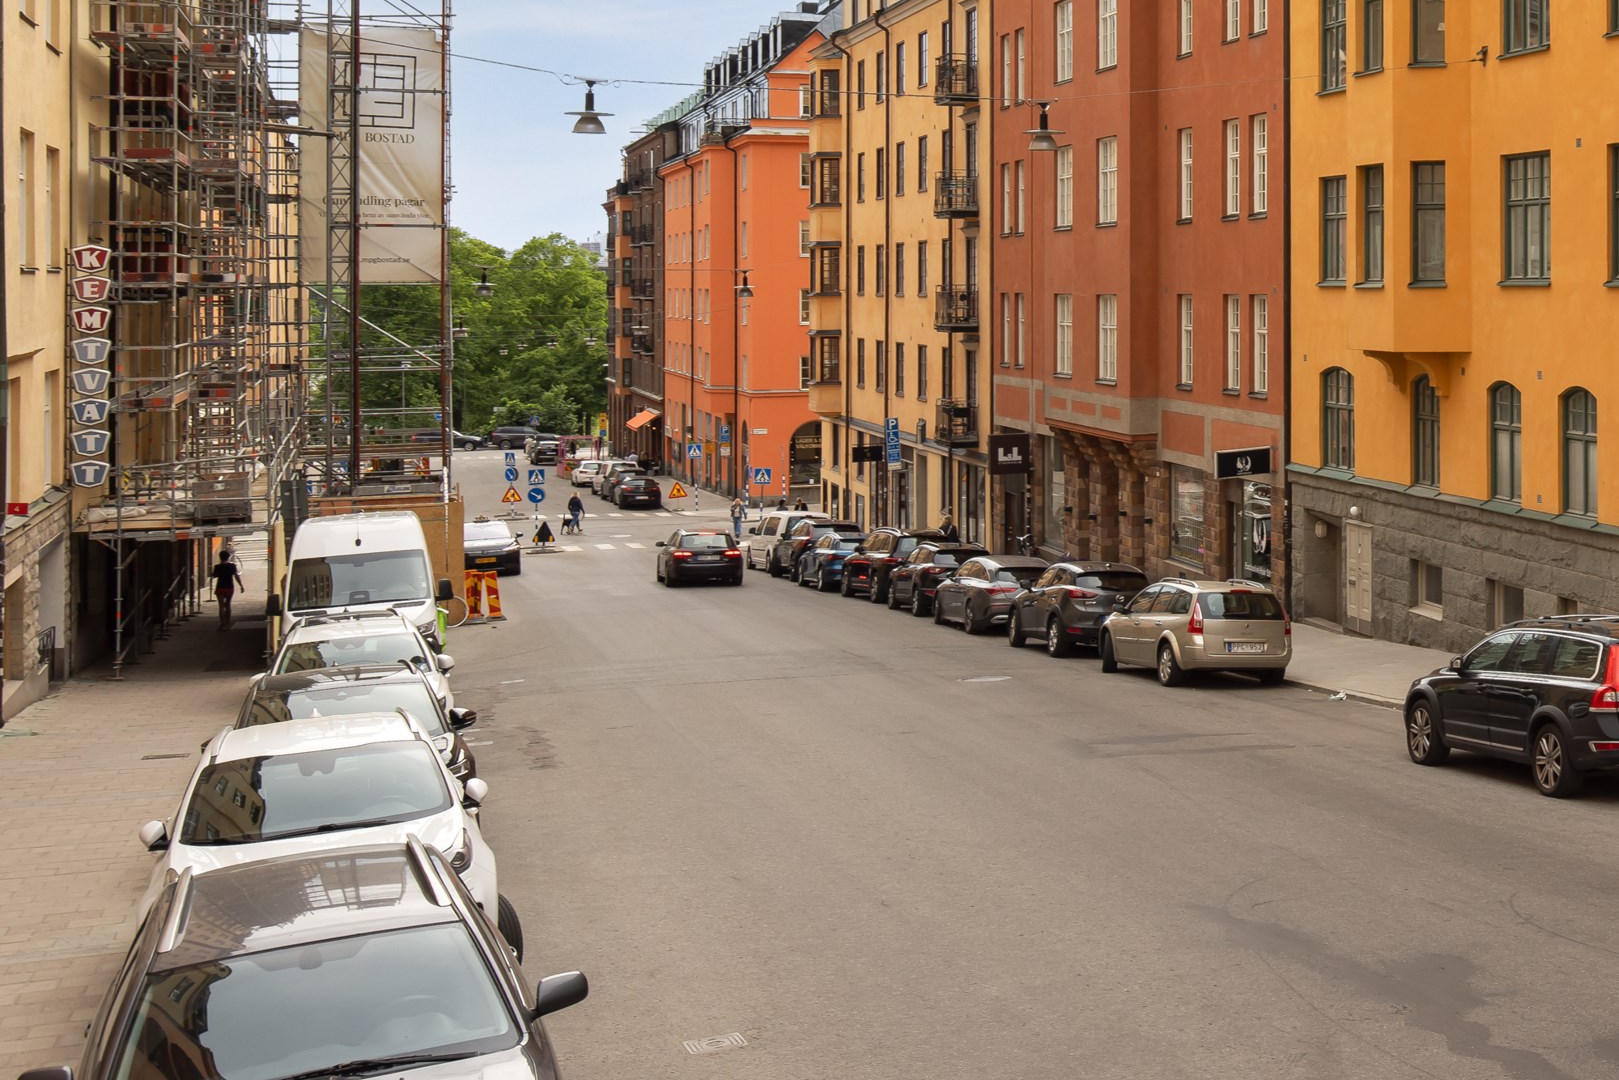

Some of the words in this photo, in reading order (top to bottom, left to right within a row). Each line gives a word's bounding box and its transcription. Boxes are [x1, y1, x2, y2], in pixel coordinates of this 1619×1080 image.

[365, 132, 415, 144] BOSTAD
[394, 196, 426, 208] pågår
[79, 249, 103, 484] KEMTVÄTT
[721, 426, 728, 434] P
[888, 419, 897, 430] P
